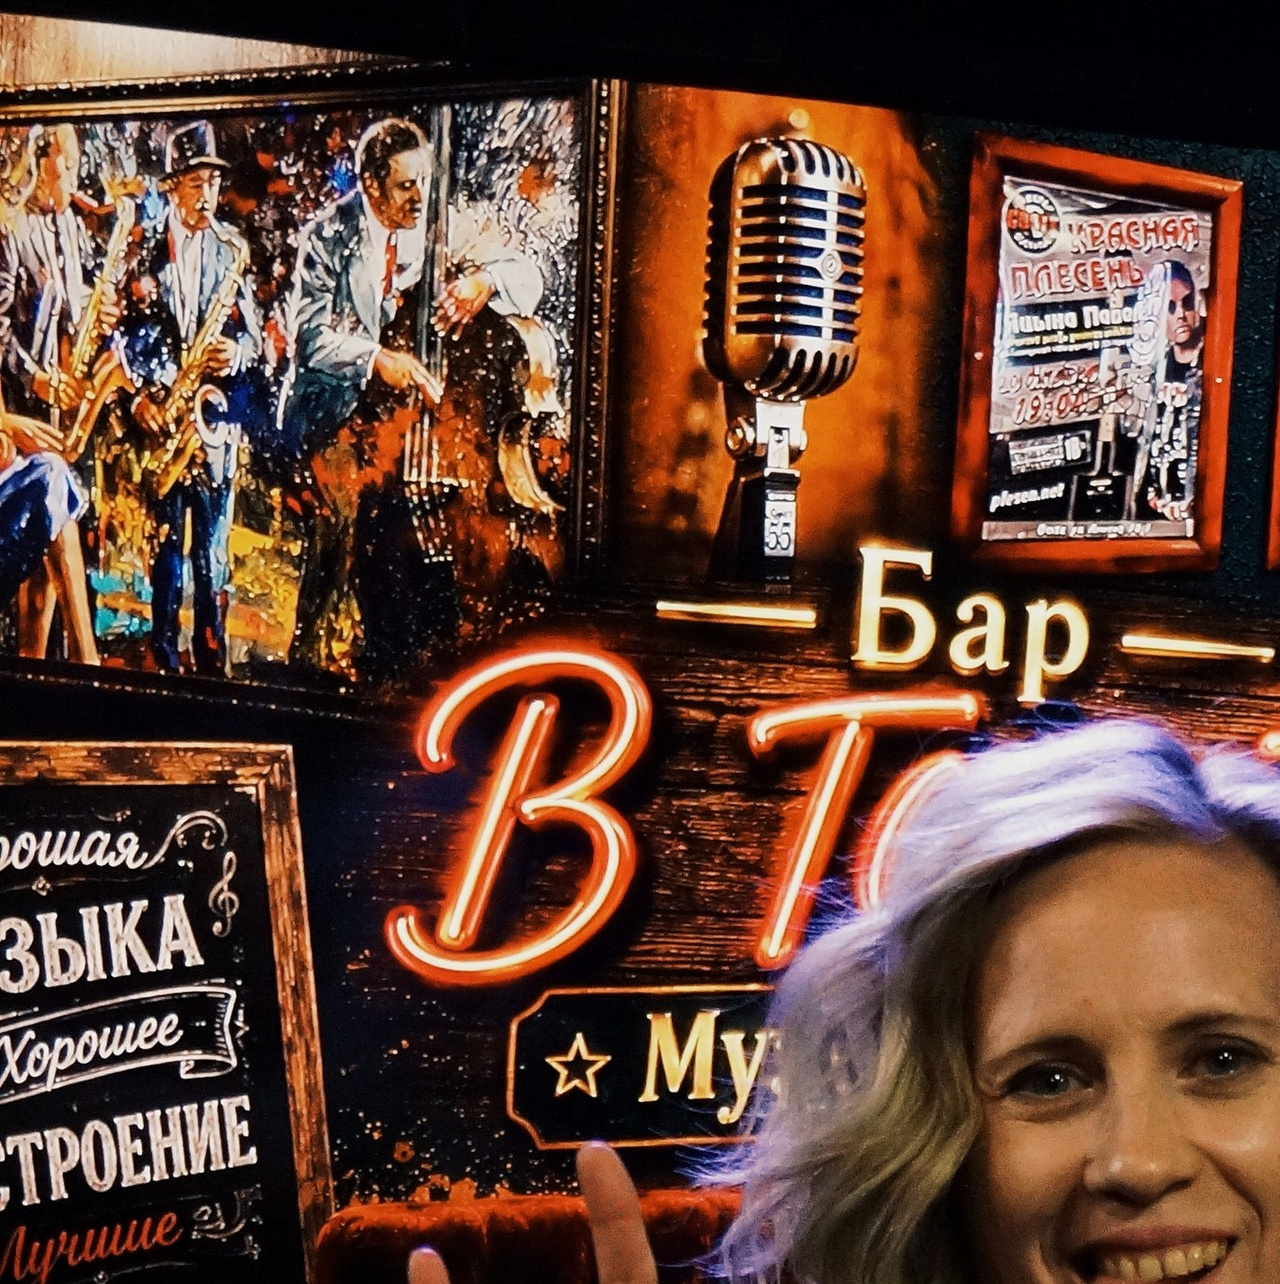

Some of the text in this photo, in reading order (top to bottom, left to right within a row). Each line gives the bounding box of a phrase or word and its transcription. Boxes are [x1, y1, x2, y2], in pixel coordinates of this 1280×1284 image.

[1009, 257, 1145, 300] ПЛЕСЕНЬ
[850, 546, 1090, 703] Бар
[386, 645, 650, 982] В
